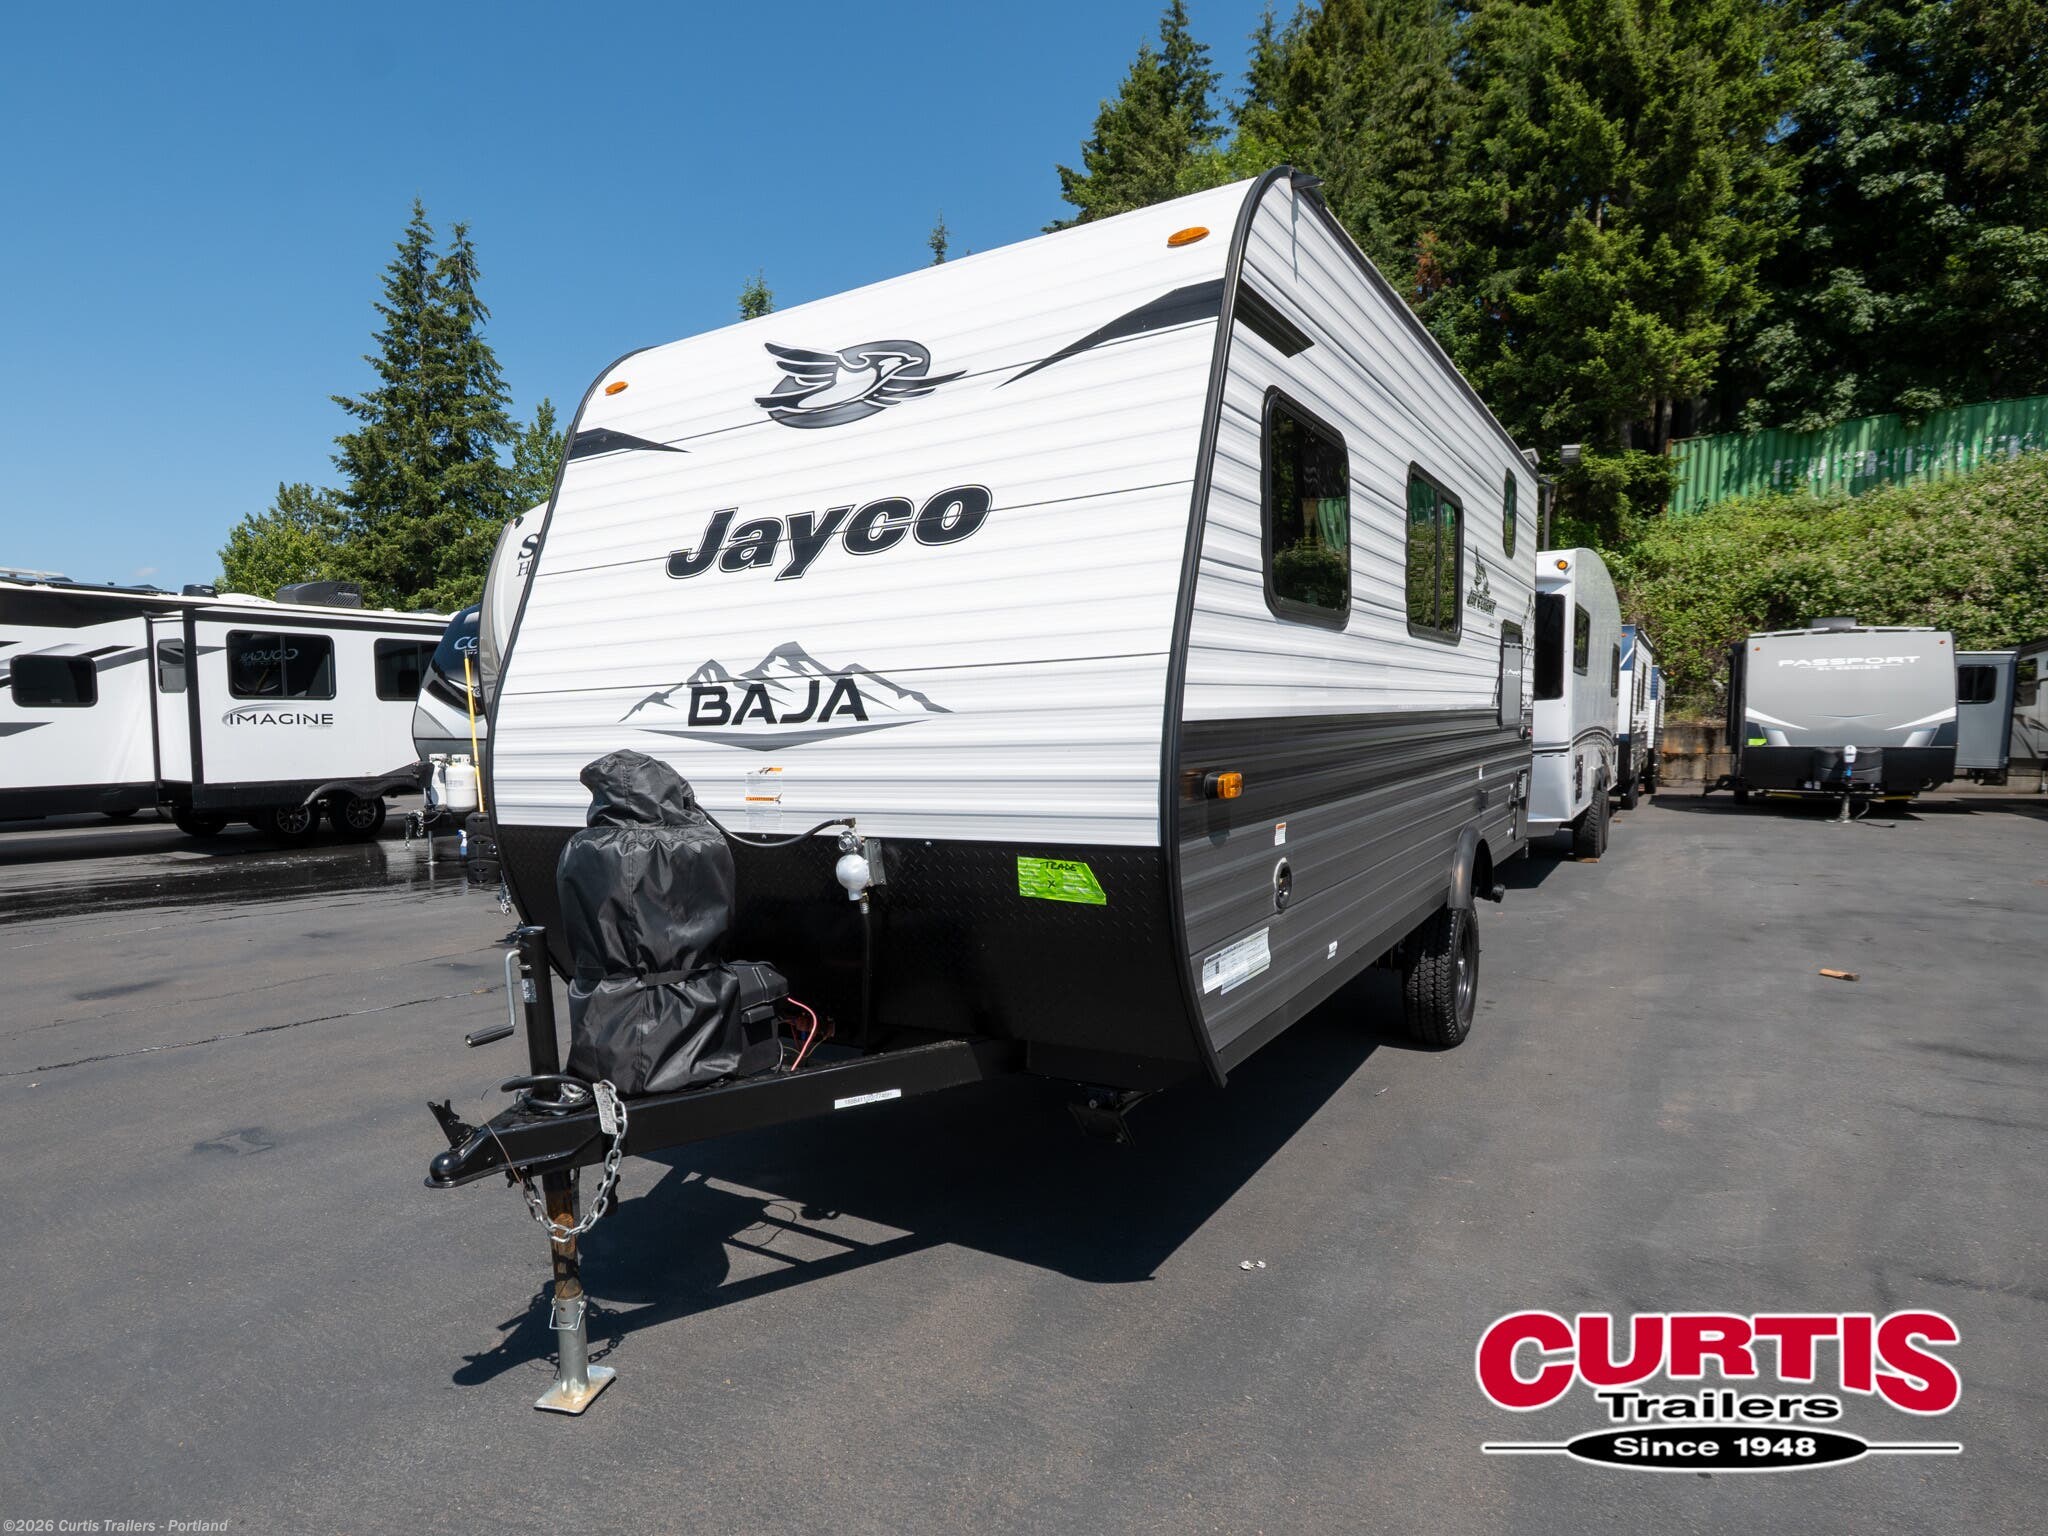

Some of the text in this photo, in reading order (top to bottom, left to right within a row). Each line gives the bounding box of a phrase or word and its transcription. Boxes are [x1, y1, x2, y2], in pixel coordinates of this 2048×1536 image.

[665, 484, 993, 582] Jayco
[1778, 656, 1920, 667] PASSPORT
[687, 678, 870, 727] BAJA
[229, 713, 334, 726] IMAGINE
